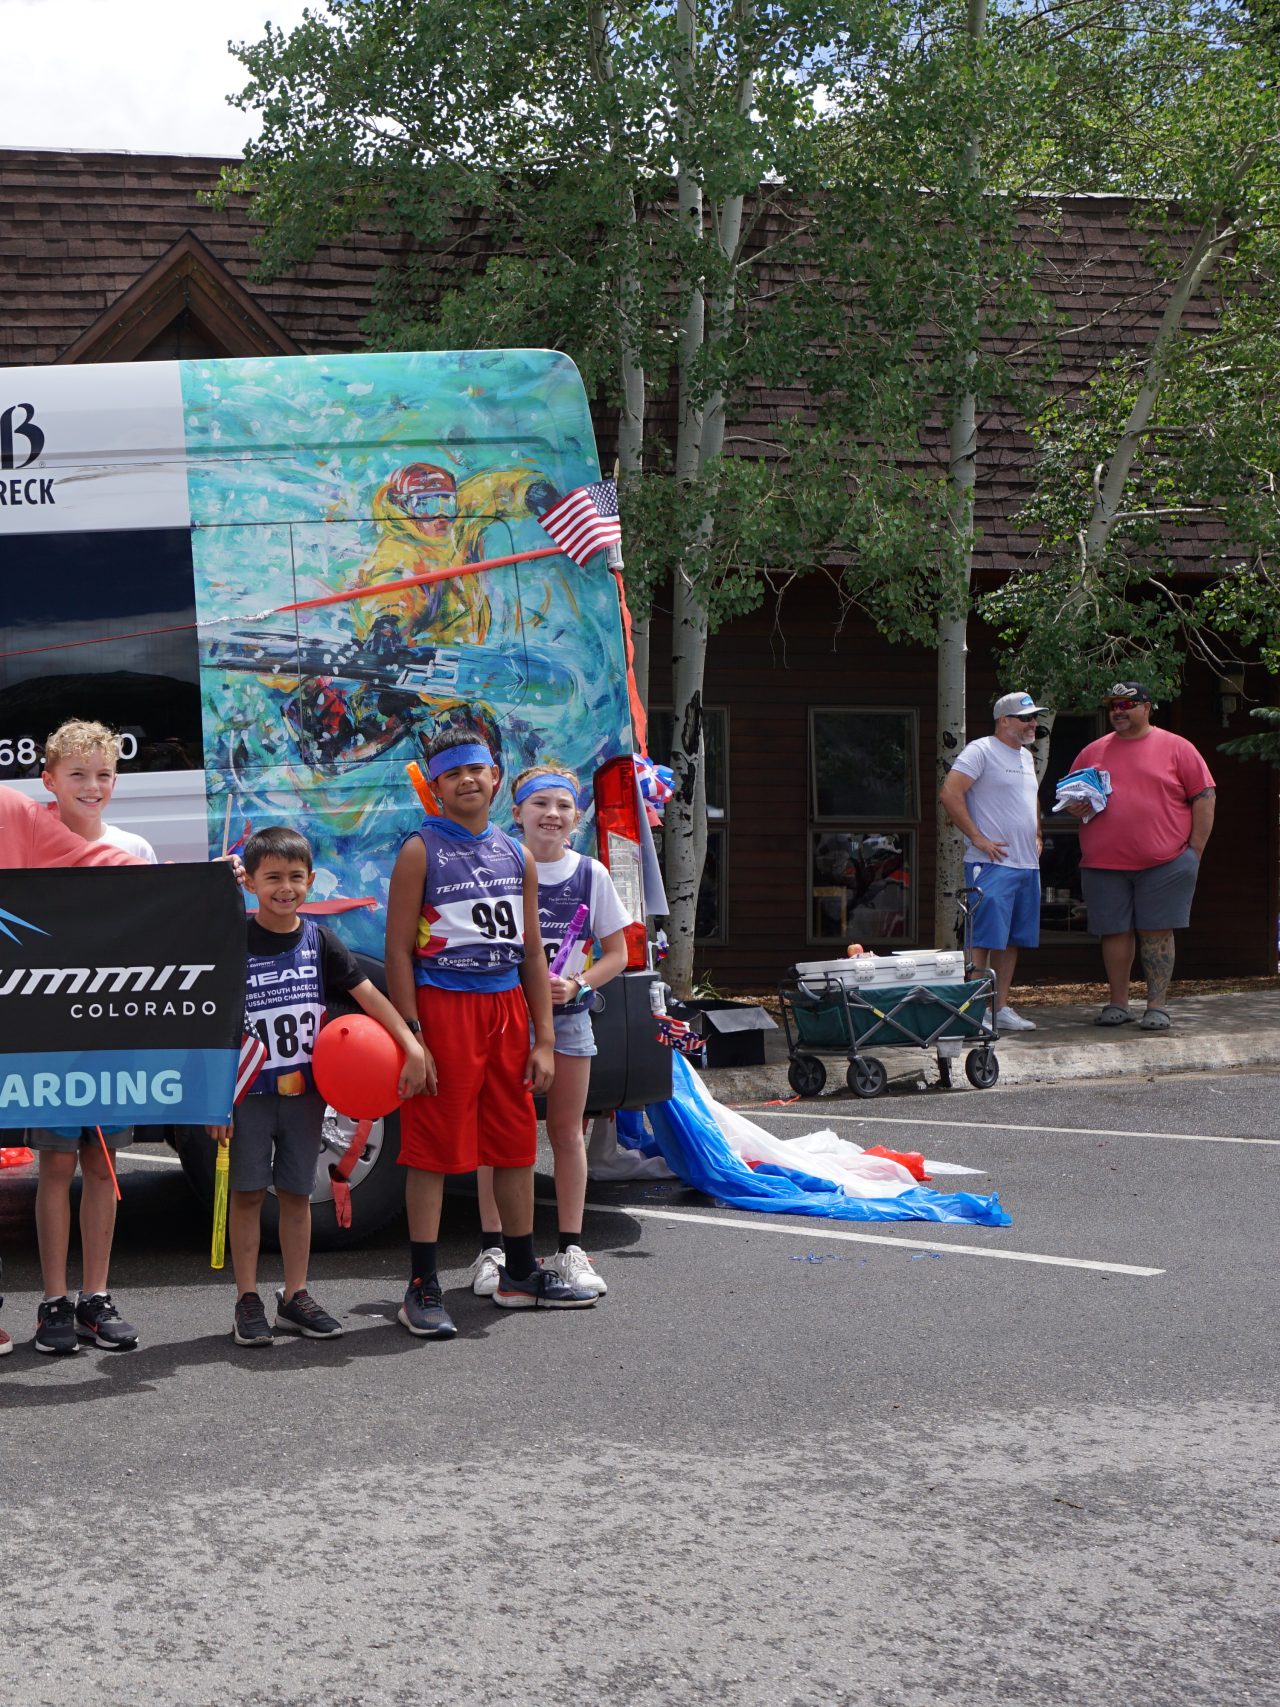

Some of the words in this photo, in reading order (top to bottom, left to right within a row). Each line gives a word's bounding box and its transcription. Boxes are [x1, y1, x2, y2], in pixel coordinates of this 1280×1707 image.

[435, 881, 475, 895] TEAM
[472, 900, 518, 940] 99
[267, 988, 291, 996] YOUTH
[70, 1000, 217, 1019] COLORADO
[254, 1010, 316, 1061] 183
